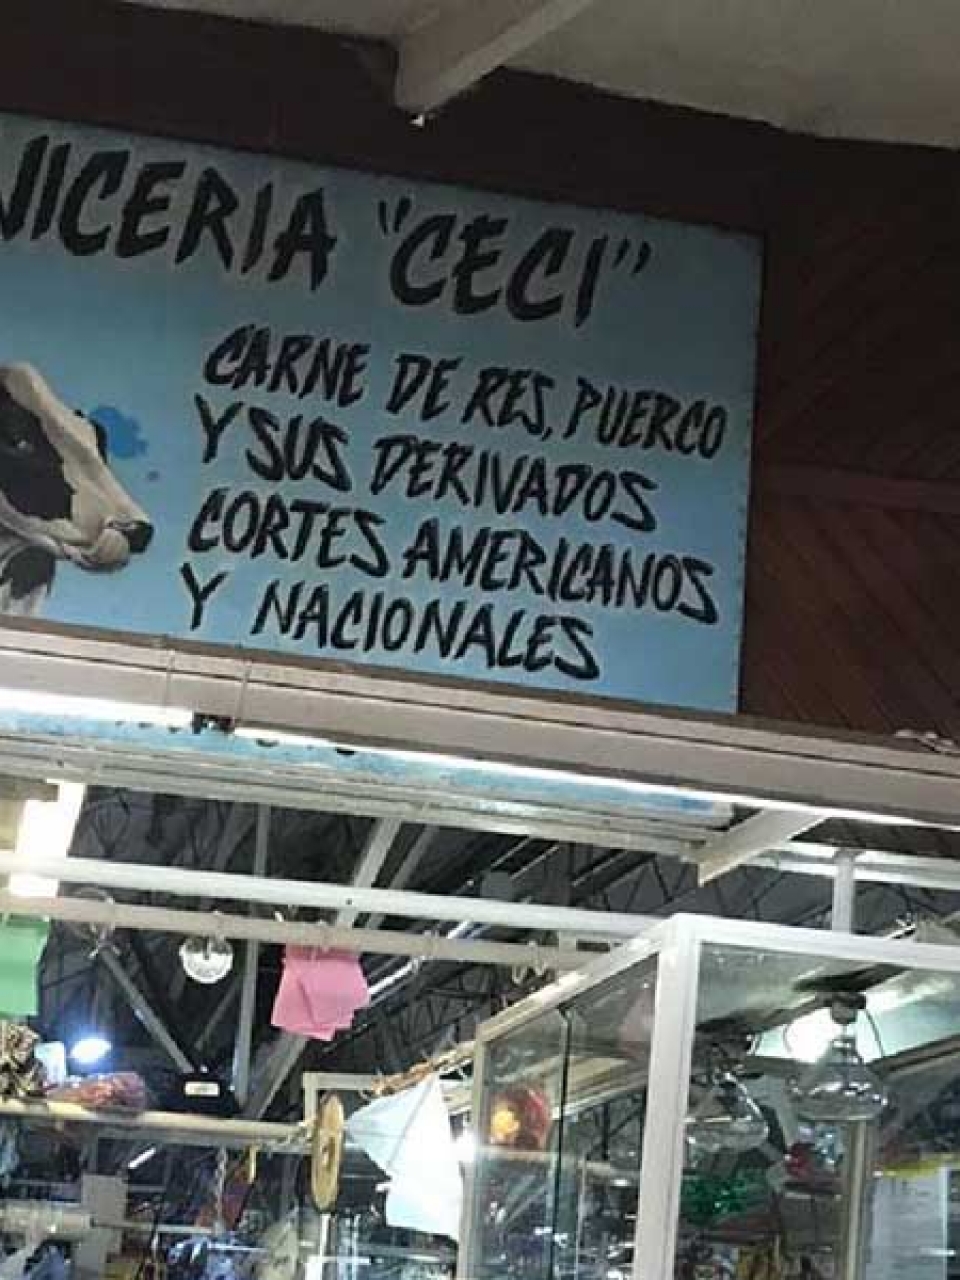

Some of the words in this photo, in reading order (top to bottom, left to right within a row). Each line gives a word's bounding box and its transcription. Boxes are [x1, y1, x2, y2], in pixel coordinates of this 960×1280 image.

[203, 324, 371, 407] CARNE
[386, 353, 463, 414] DE
[461, 366, 554, 441] RES,
[563, 377, 728, 459] PUERCO
[194, 394, 241, 463] Y
[246, 407, 351, 492] SUS
[370, 436, 658, 532] DERIVADOS
[181, 563, 229, 630] Y
[252, 581, 600, 680] NACIONALES
[187, 488, 390, 578] CORTES
[403, 518, 719, 624] AMERICANOS
